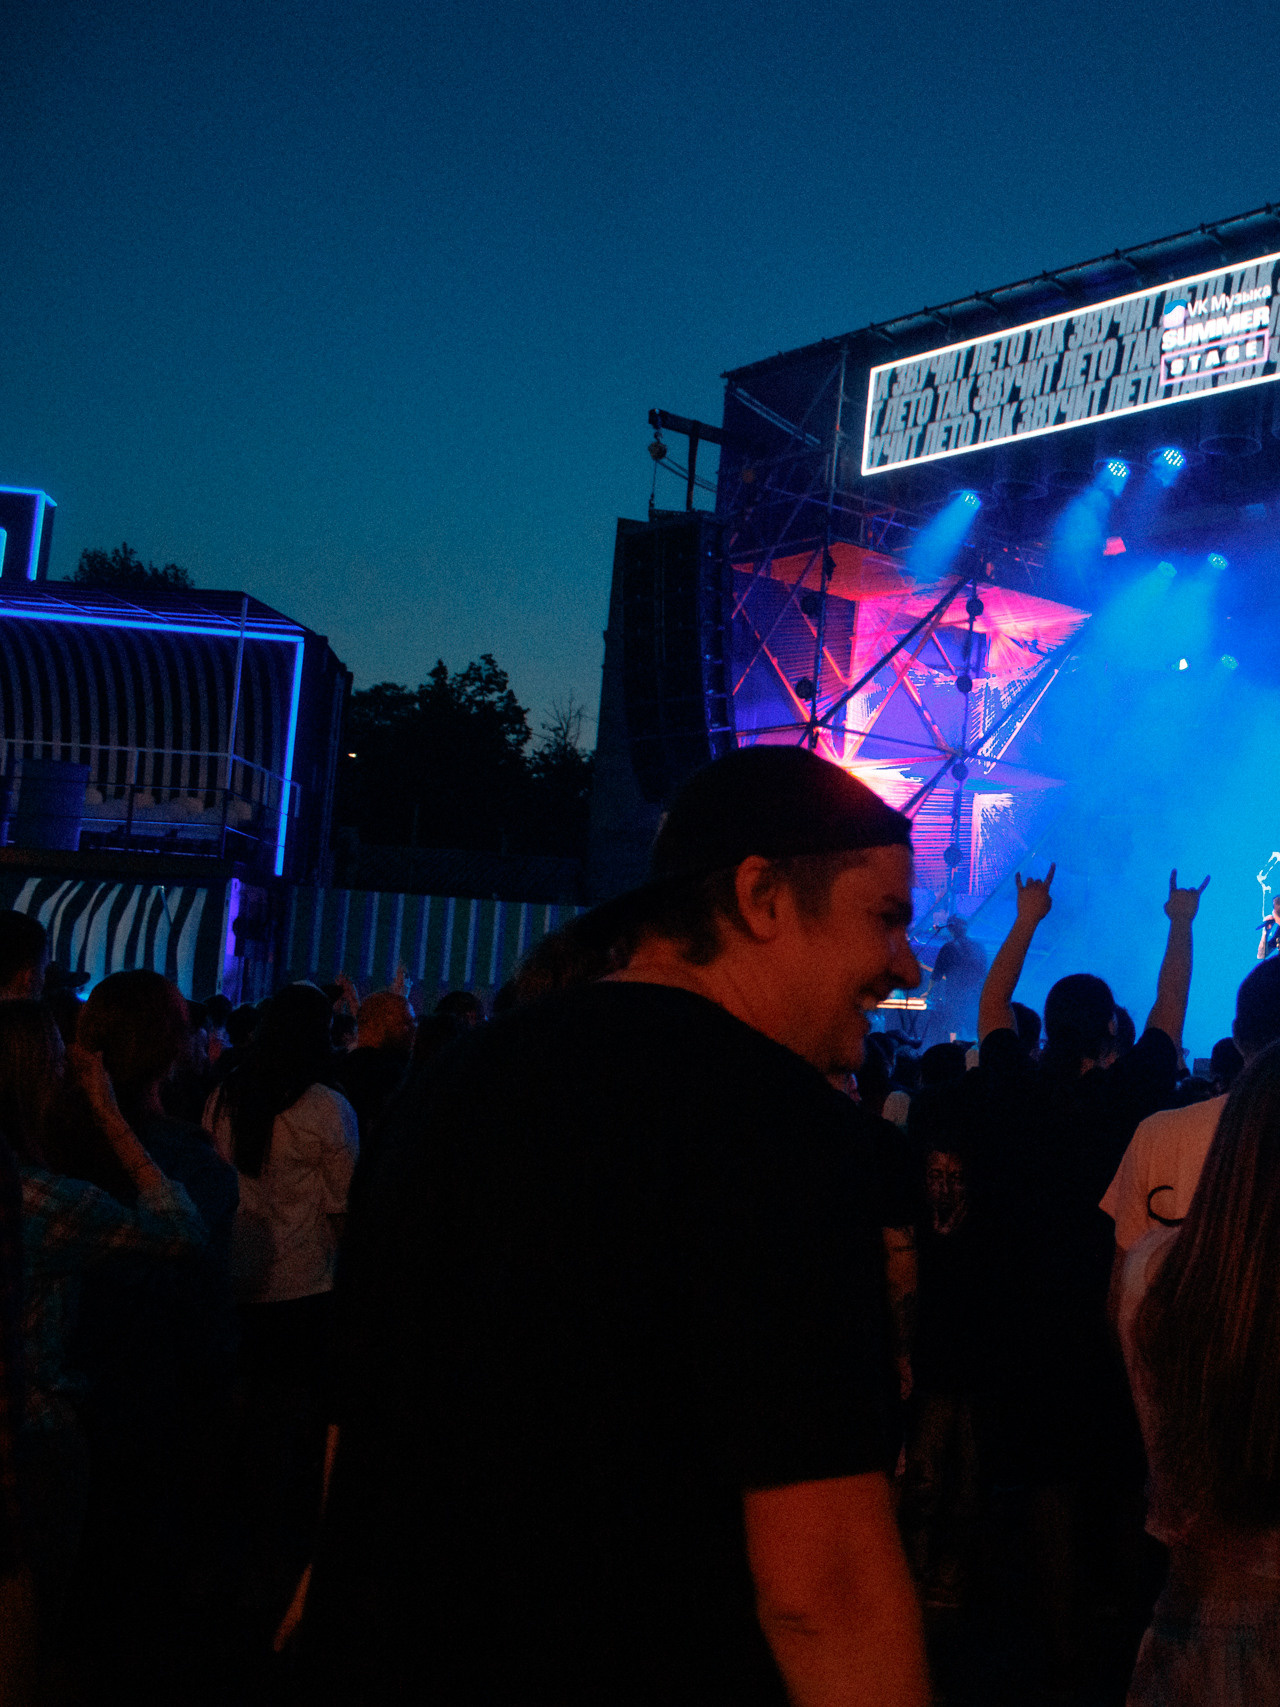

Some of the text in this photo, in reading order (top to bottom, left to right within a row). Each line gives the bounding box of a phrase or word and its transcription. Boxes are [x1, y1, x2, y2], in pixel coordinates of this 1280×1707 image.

[1161, 305, 1271, 351] SUMMER
[1187, 285, 1272, 318] VK Музыка
[969, 331, 1027, 377] ЛЕТО
[1027, 319, 1069, 362] ТАК
[1068, 292, 1161, 350] ЗВУЧИТ
[1169, 340, 1258, 376] STAGE
[881, 387, 935, 435] ЛЕТО
[935, 376, 975, 422] ТАК
[972, 354, 1059, 412] ЗВУЧИТ
[1057, 338, 1119, 392] ЛЕТО
[1119, 326, 1163, 376] ТАК
[919, 412, 976, 458] ЛЕТО
[977, 401, 1019, 444] ТАК
[1015, 378, 1106, 434] ЗВУЧИТ
